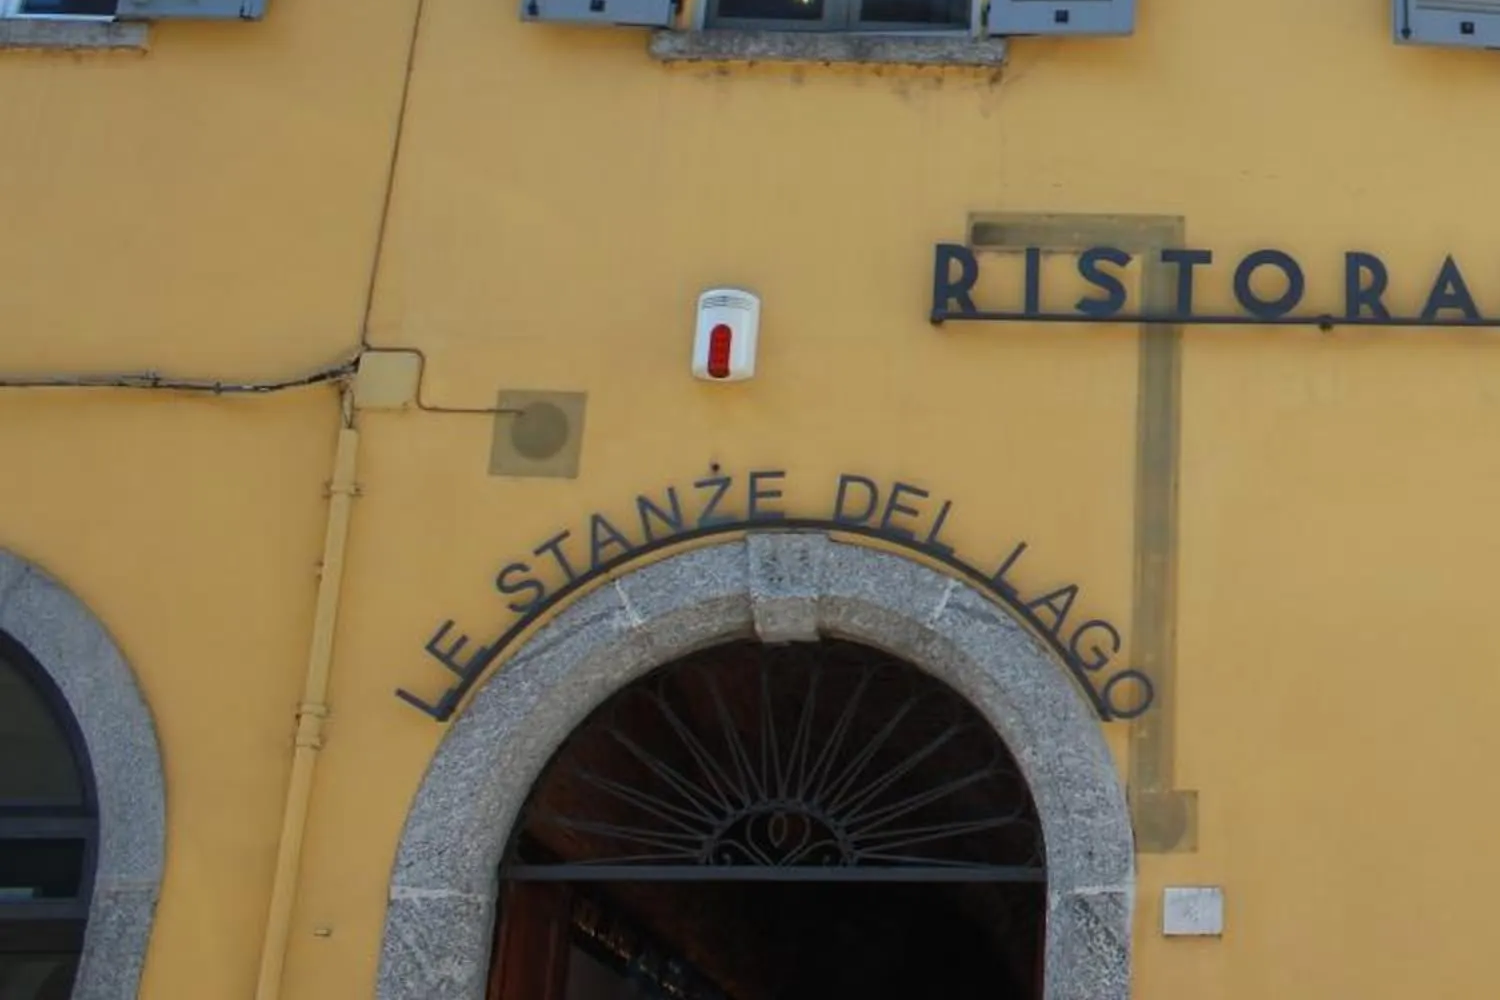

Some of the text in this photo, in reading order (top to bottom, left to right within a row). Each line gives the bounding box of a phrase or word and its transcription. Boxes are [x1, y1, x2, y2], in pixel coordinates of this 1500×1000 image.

[394, 468, 1155, 720] LE STANZE DEL LAGO
